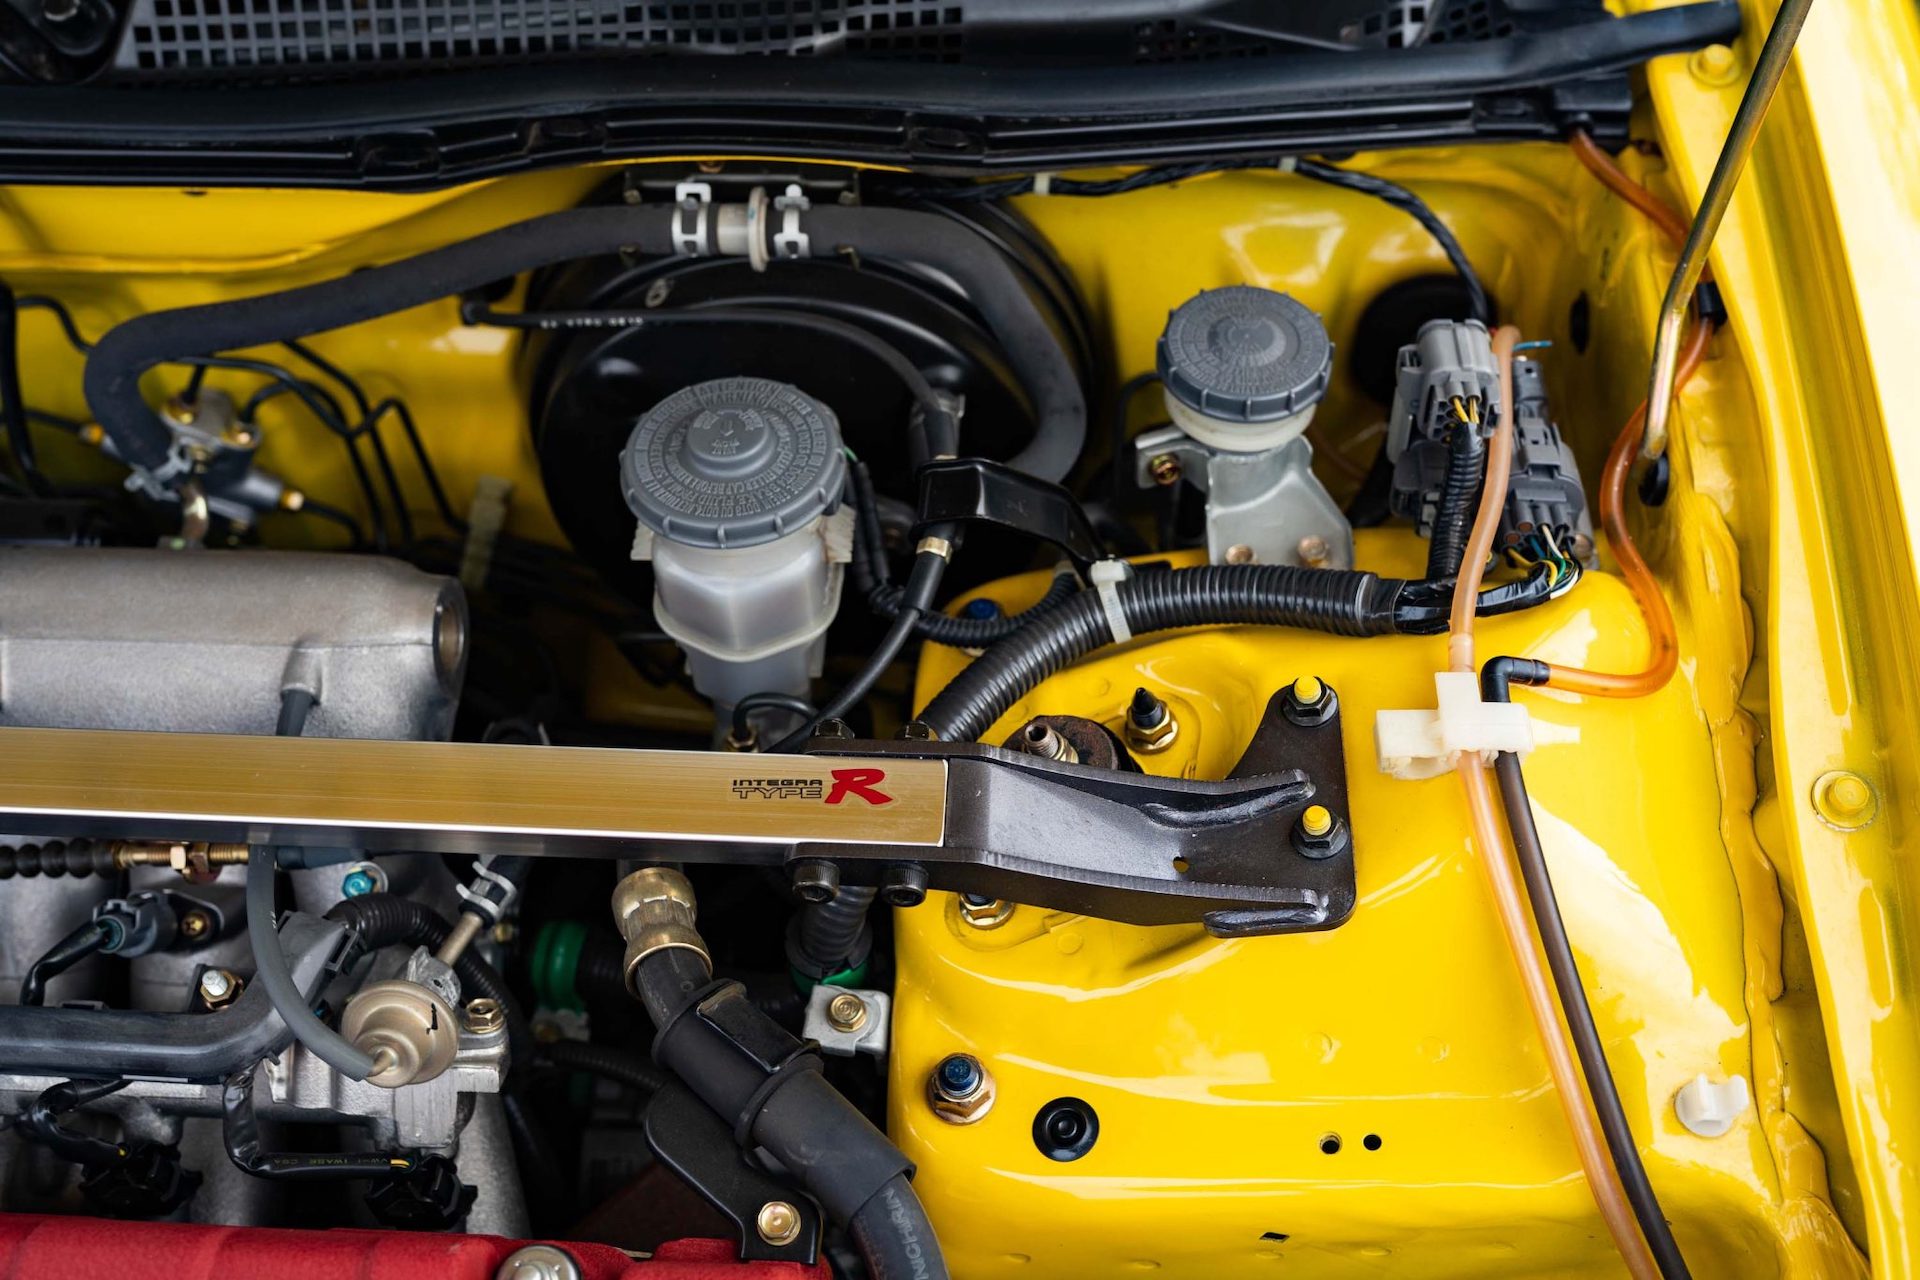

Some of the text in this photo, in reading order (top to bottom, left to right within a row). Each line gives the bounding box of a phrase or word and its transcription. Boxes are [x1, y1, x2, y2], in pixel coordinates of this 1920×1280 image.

[697, 379, 777, 397] ATTENTION
[701, 390, 769, 408] WARNING
[732, 768, 894, 805] TYPE R
[733, 779, 823, 787] INTEGRA
[881, 1186, 930, 1280] NICHIRIN
